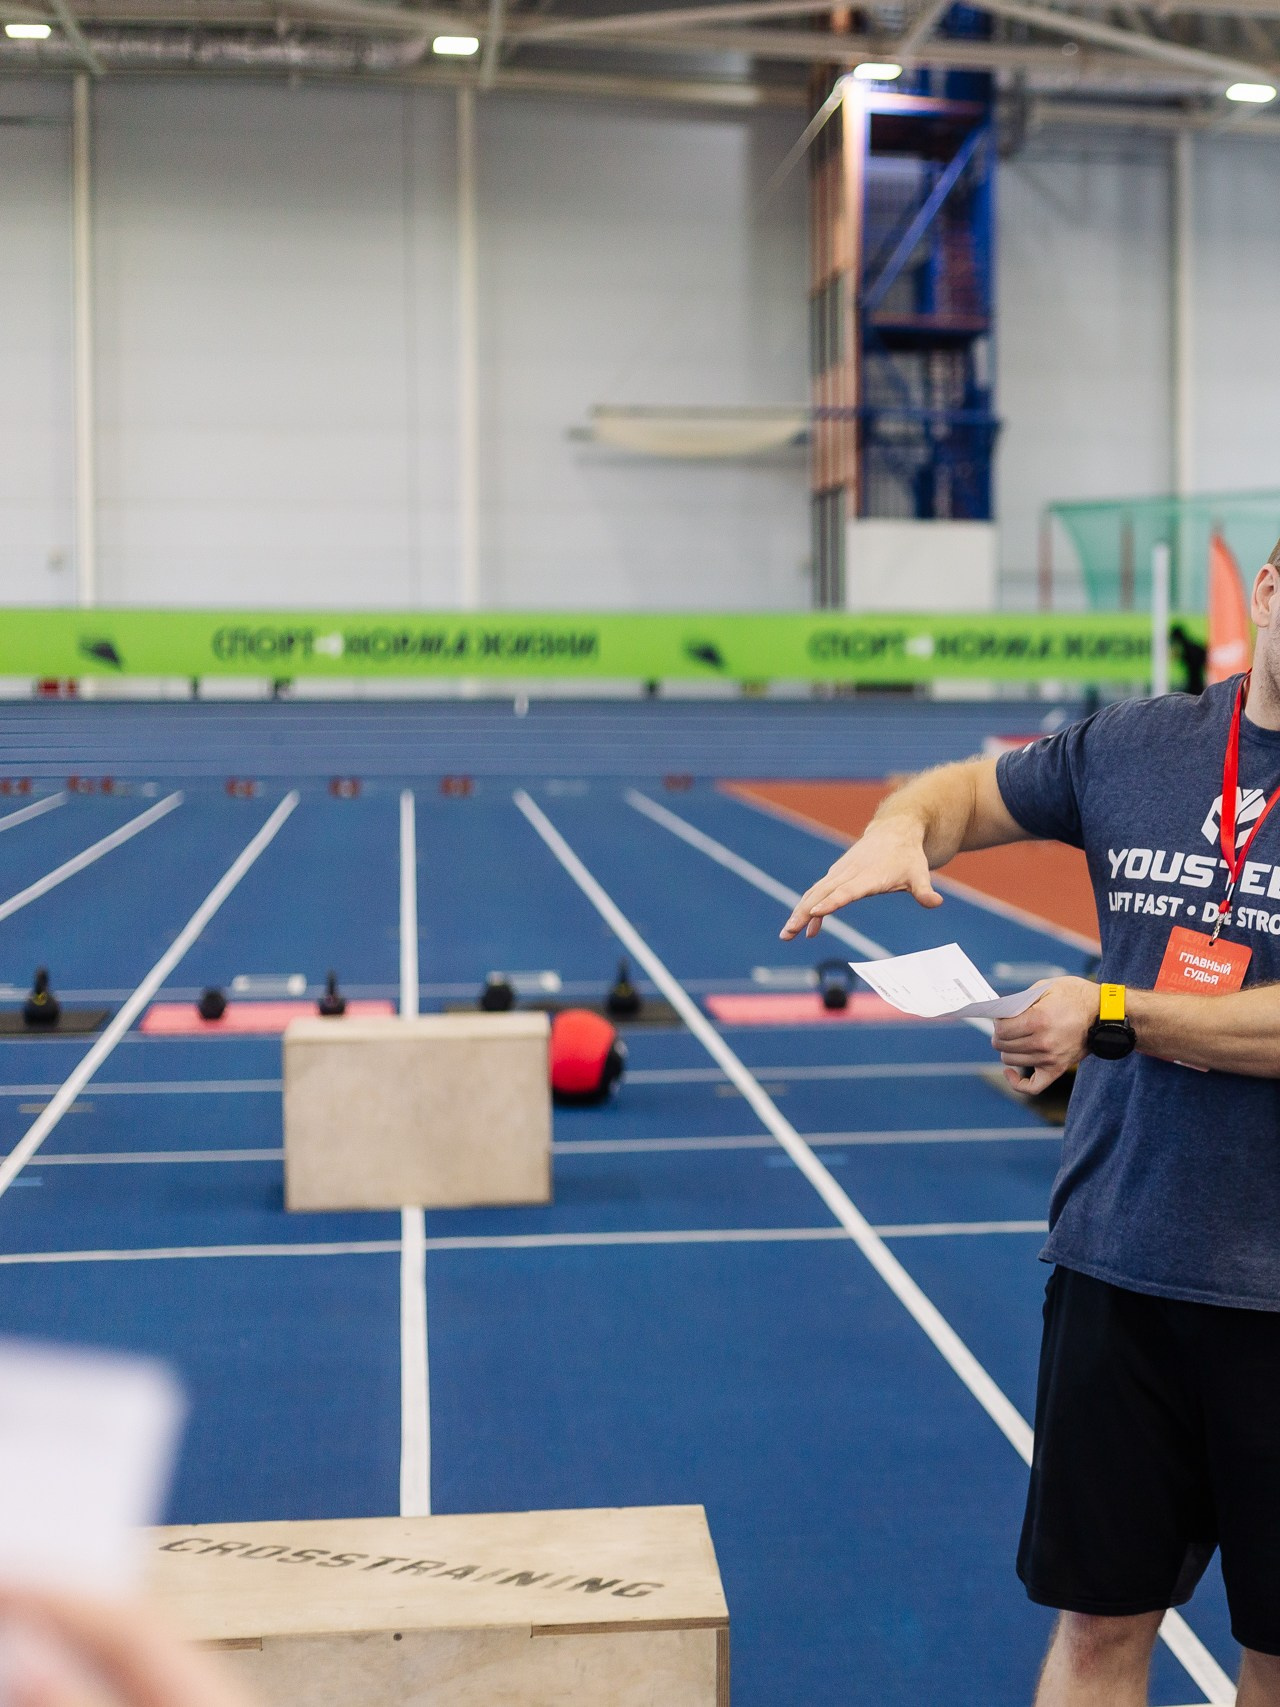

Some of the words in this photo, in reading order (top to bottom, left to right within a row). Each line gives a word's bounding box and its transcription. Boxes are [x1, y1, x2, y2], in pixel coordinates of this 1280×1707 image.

[1060, 630, 1152, 660] ЖИЗН
[1108, 891, 1131, 912] LIFT
[1133, 892, 1184, 918] FAST
[1178, 951, 1233, 976] ГЛАВНЫЙ
[1183, 966, 1220, 985] СУДЬЯ
[157, 1537, 667, 1599] CROSSTRAINING
